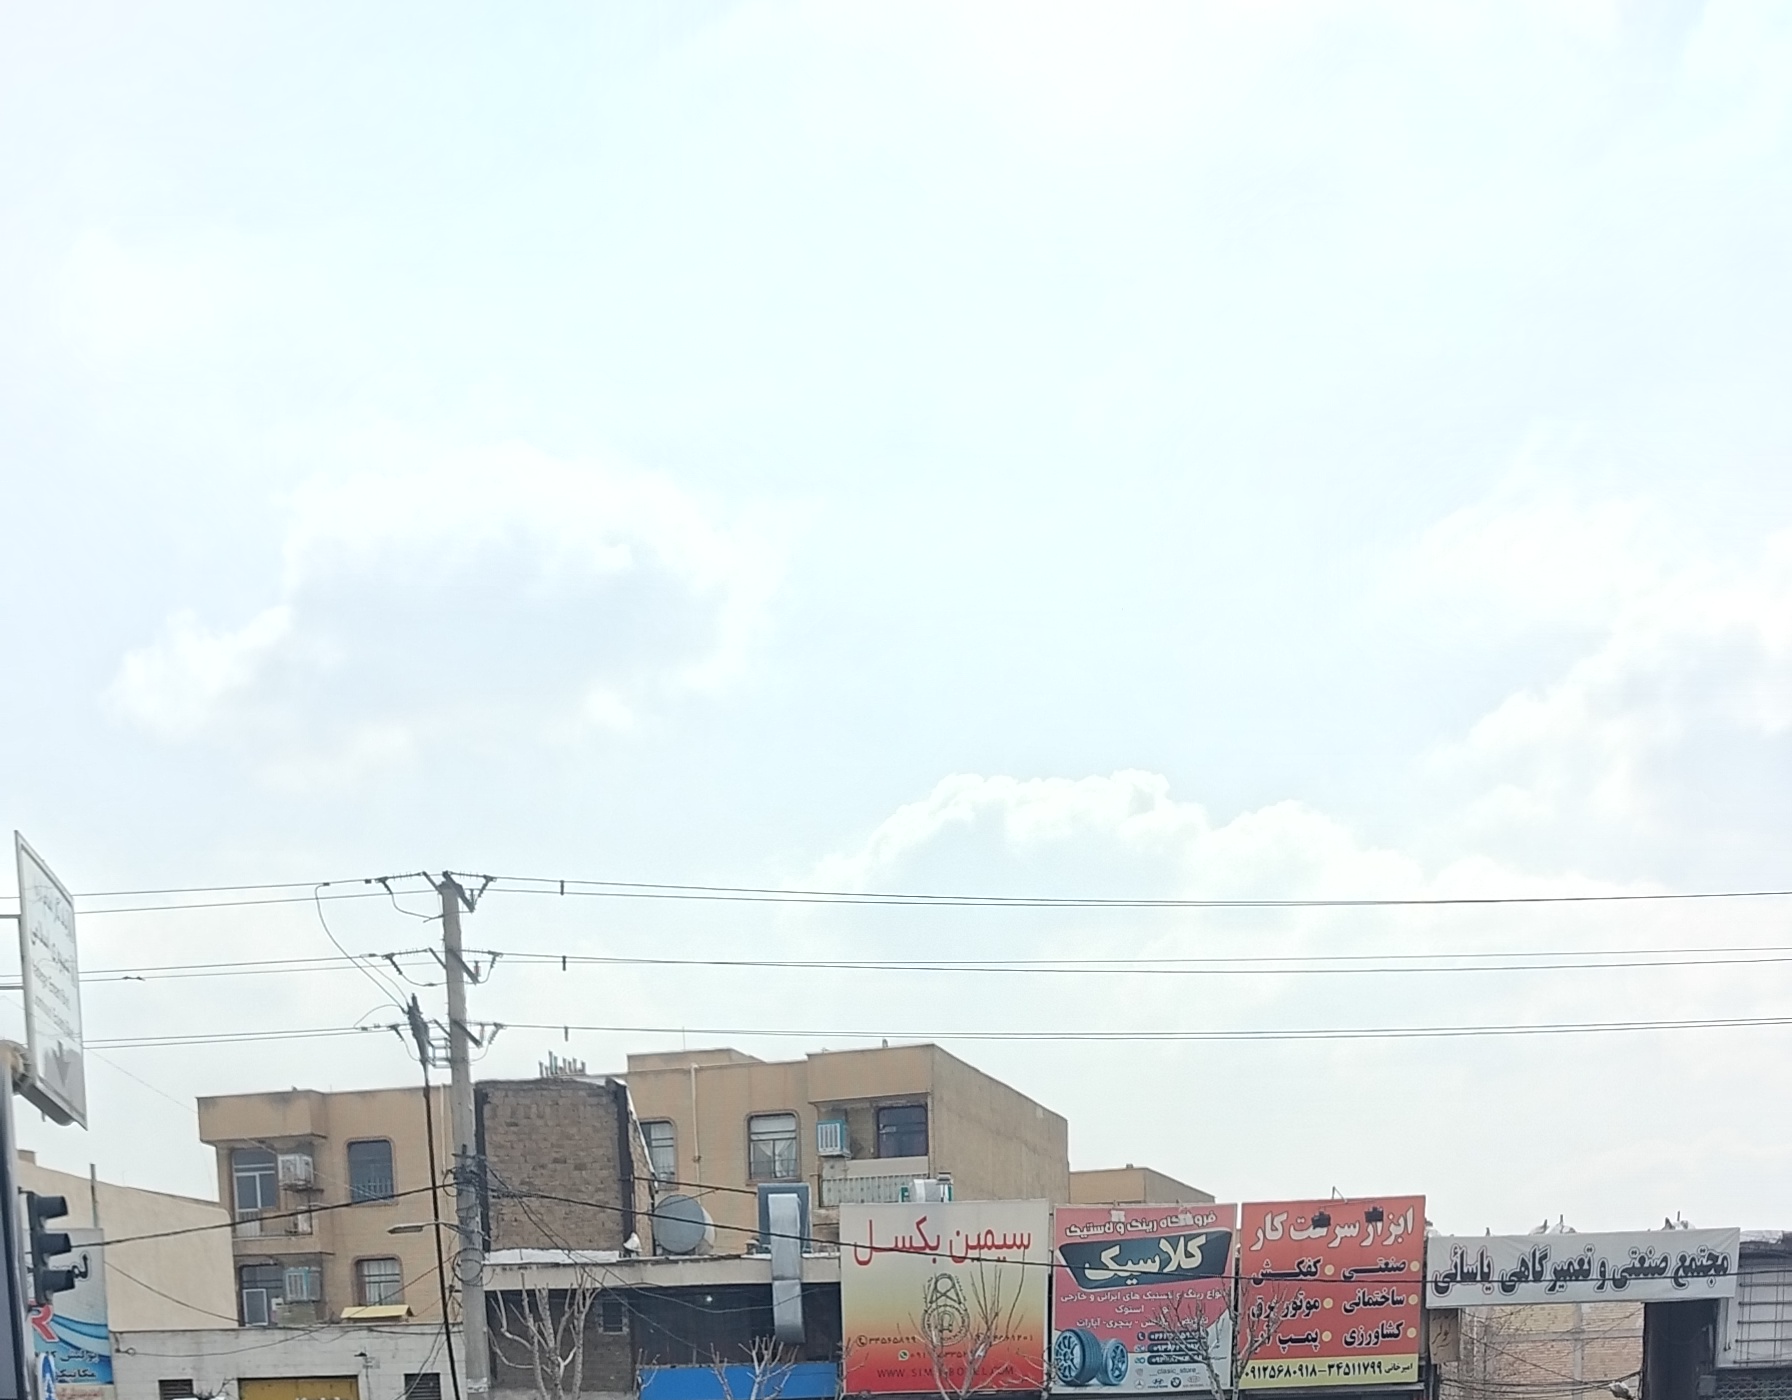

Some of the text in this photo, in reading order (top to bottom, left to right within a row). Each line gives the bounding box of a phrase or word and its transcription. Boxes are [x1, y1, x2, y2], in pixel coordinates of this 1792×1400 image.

[1126, 1217, 1158, 1233] رینگ
[1250, 1211, 1289, 1251] کار
[853, 1215, 1032, 1266] سیمین بکسل
[1084, 1234, 1207, 1285] کلاسیک
[1252, 1257, 1323, 1286] کفکش
[1342, 1256, 1408, 1281] صنعتی
[1610, 1246, 1671, 1291] صنعتی
[1672, 1246, 1730, 1288] مجتمع
[1594, 1256, 1607, 1293] و
[1281, 1291, 1321, 1319] موتور
[1342, 1287, 1406, 1315] ساختمانی
[1277, 1327, 1321, 1353] پمپ
[1343, 1321, 1405, 1347] کشاورزی
